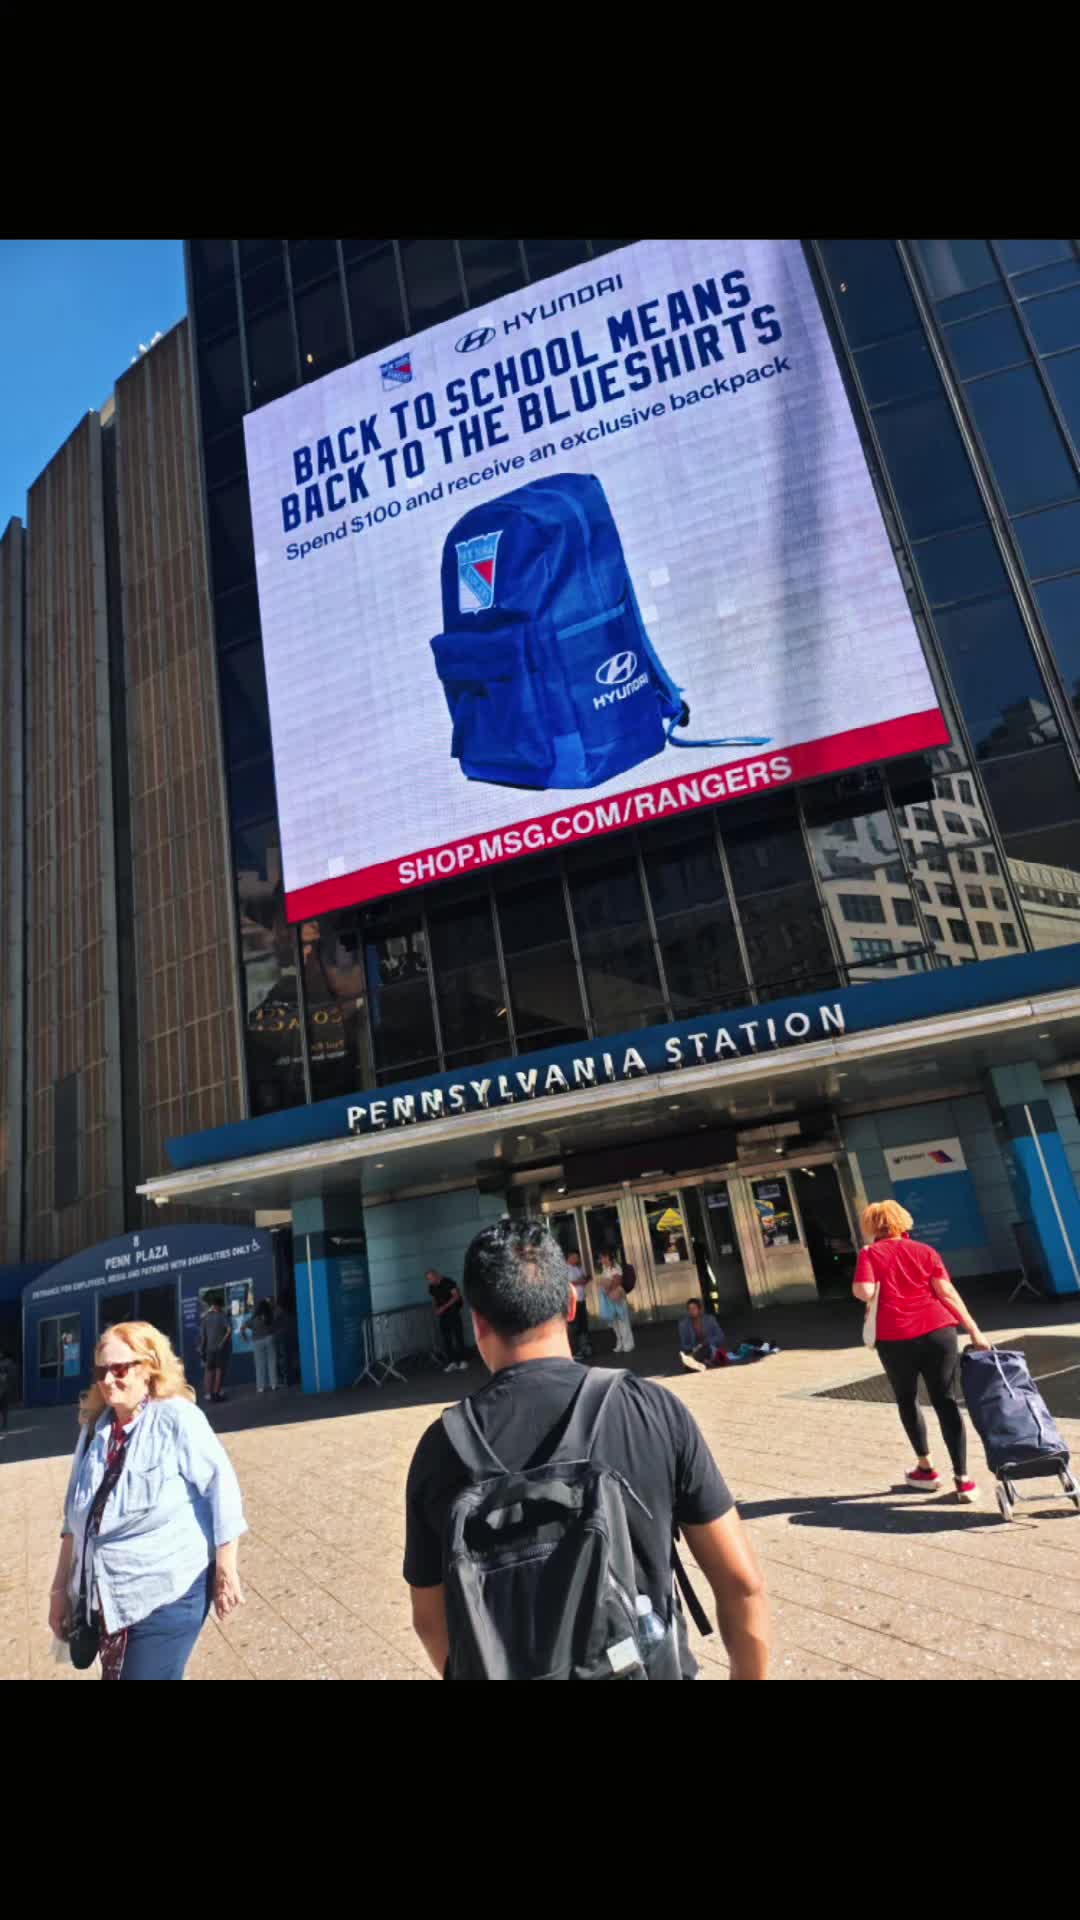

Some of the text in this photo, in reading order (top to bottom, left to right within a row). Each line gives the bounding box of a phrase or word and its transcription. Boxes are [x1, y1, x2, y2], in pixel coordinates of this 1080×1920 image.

[503, 274, 623, 335] HYUNDAI
[281, 303, 783, 533] BACK TO THE BLUESHIRTS
[293, 414, 382, 486] BACK
[390, 392, 436, 441] TO
[446, 329, 599, 417] SCHOOL
[607, 269, 752, 354] MEANS
[286, 355, 792, 560] Spend $100 and receive an exclusive backpack
[592, 672, 649, 710] HYUNDAI
[398, 755, 793, 885] SHOP.MSG.COM/RANGERS
[347, 1003, 846, 1131] PENNSYLVANIA STATION
[105, 1245, 169, 1270] PENN PLAZA
[170, 1259, 187, 1271] WITH
[188, 1248, 232, 1267] DISABILITIES
[232, 1244, 251, 1257] ONLY
